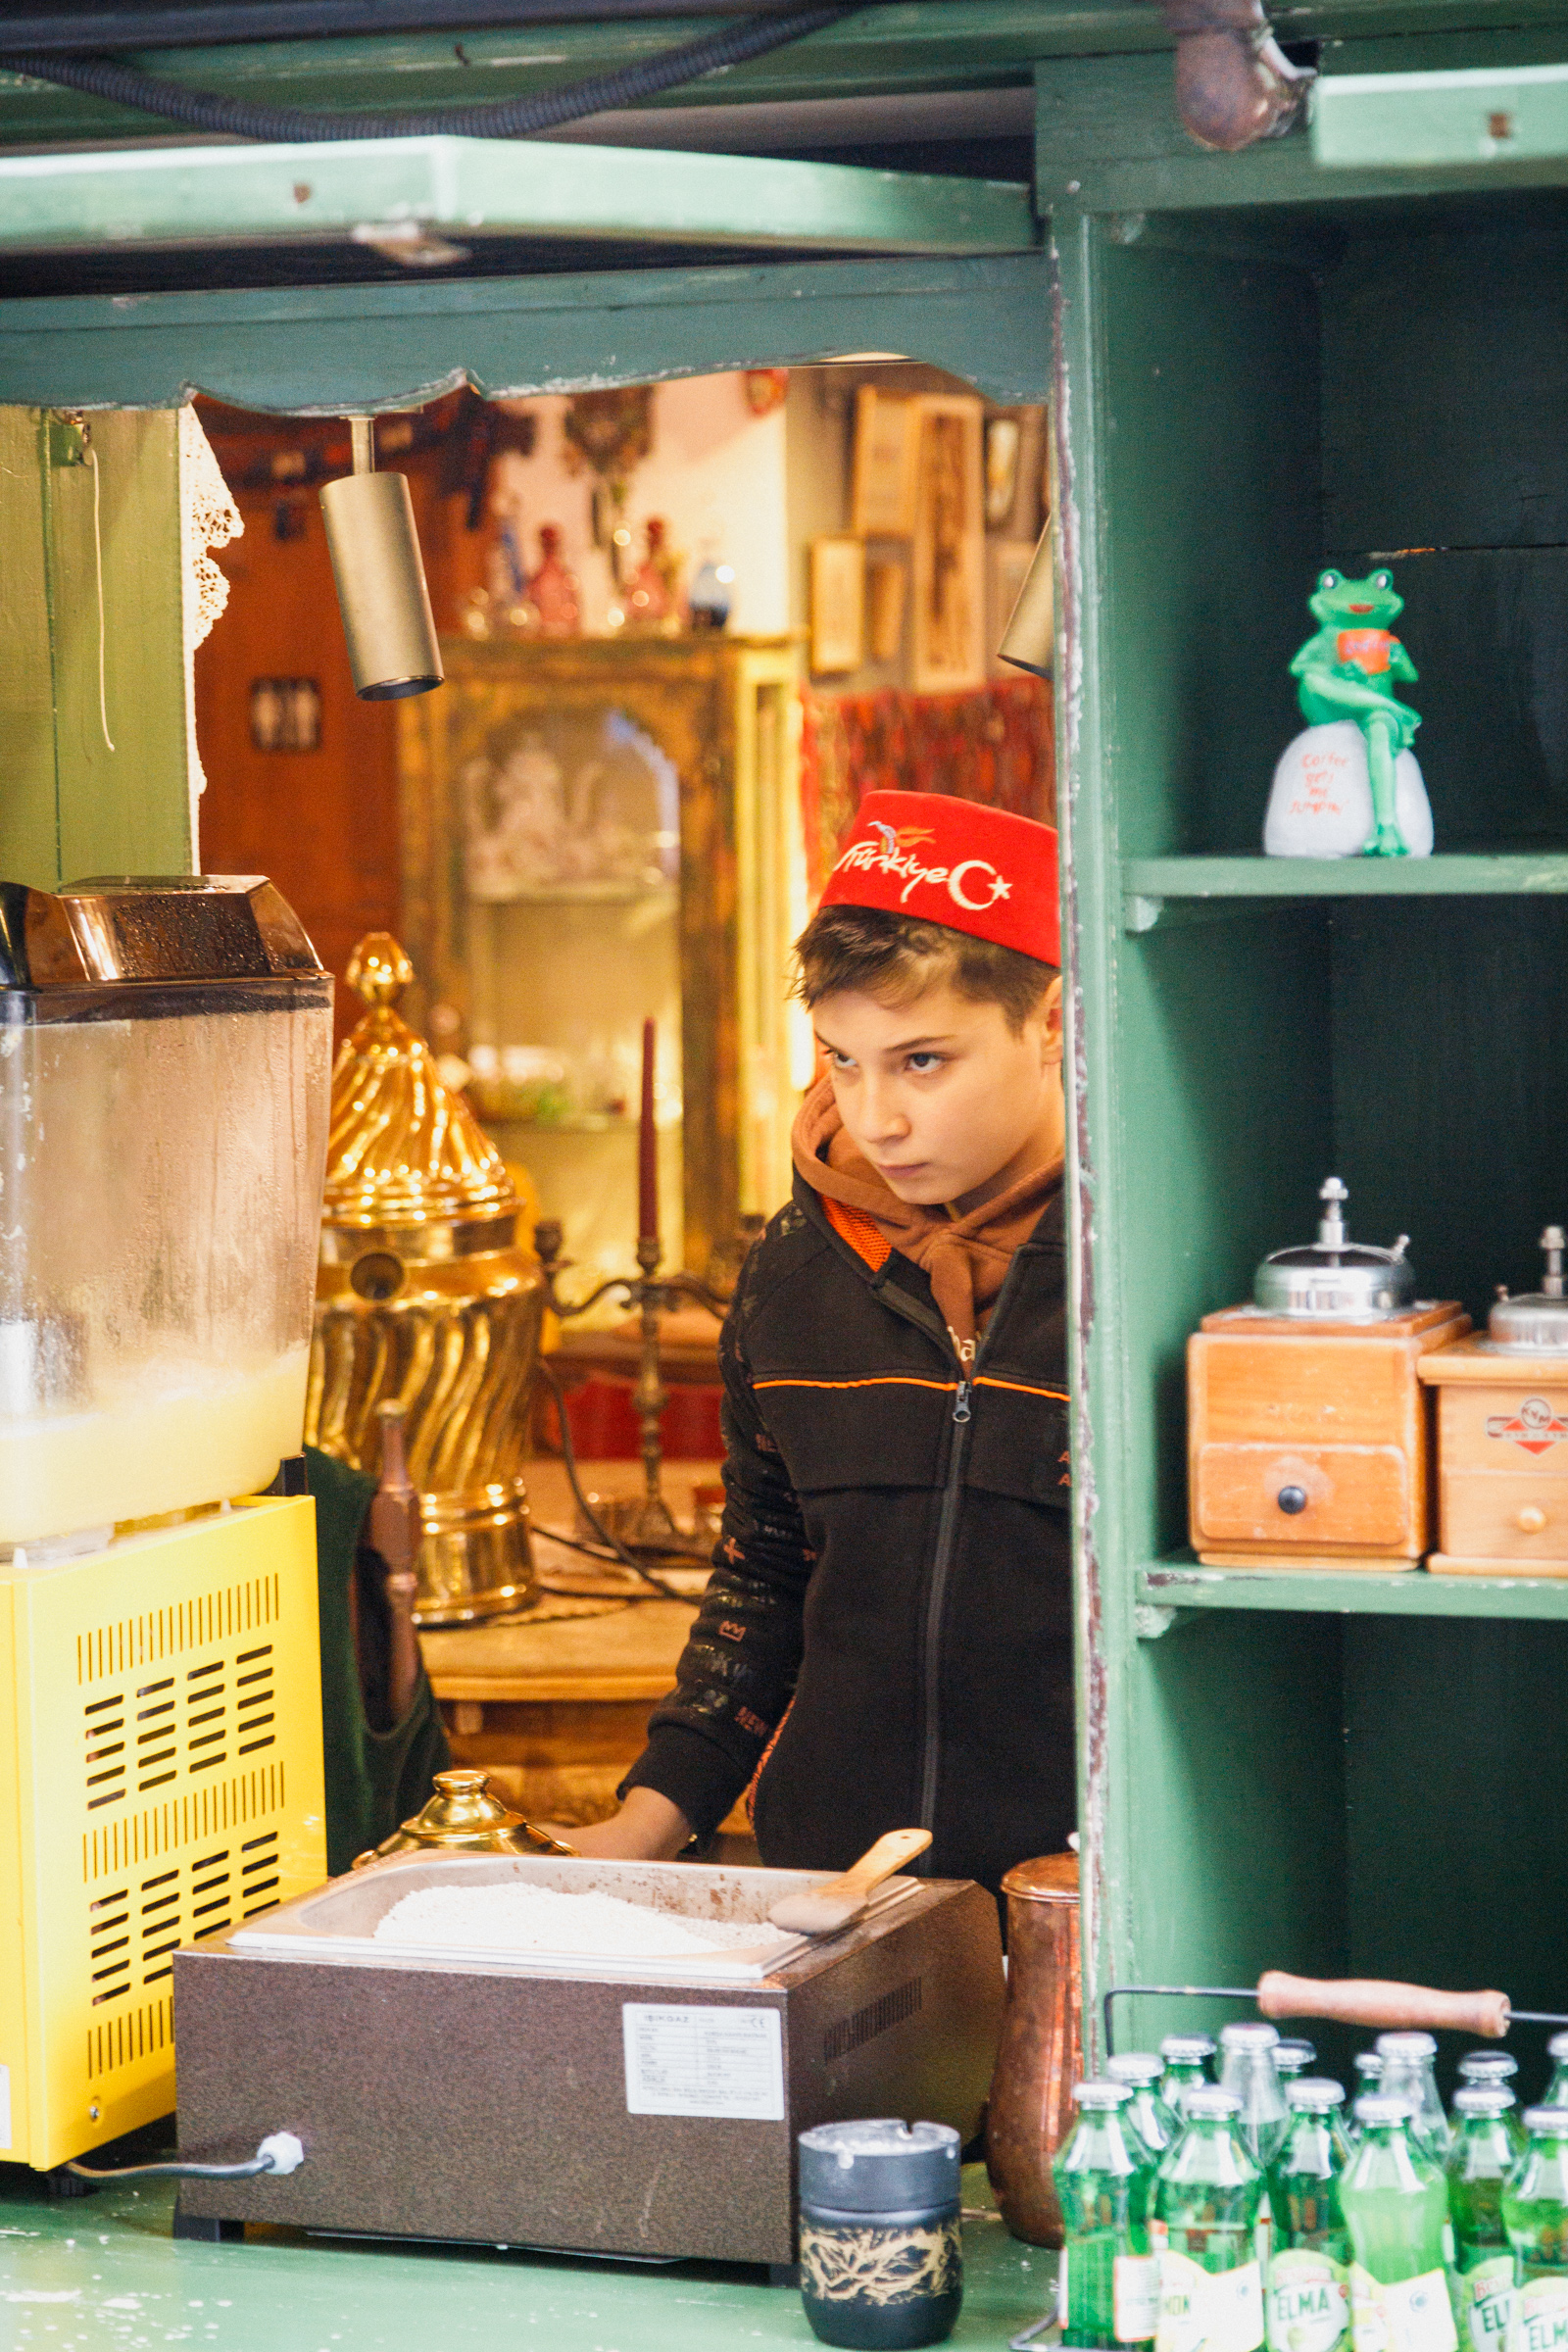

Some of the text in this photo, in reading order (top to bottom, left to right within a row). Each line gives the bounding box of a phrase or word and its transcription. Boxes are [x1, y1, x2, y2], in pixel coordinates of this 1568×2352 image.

[833, 841, 950, 904] Türkiye
[1276, 2286, 1331, 2322] ELMA
[1529, 2319, 1568, 2351] ELM
